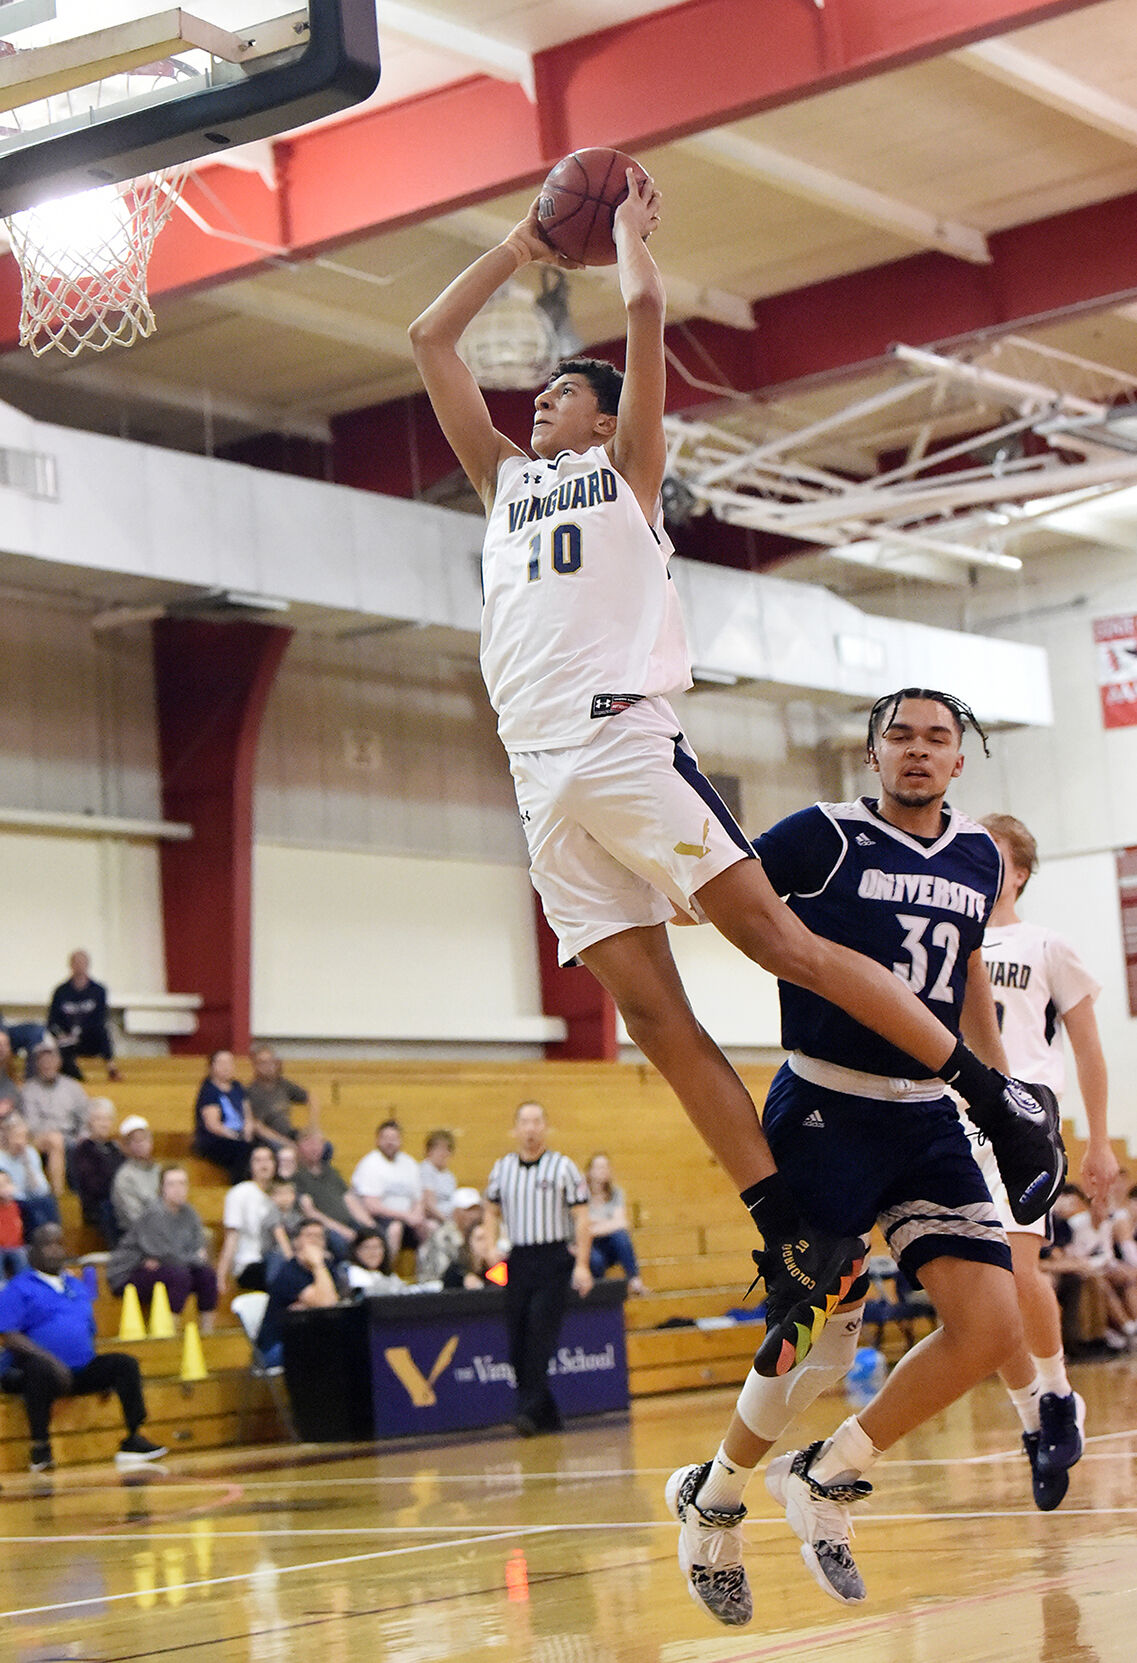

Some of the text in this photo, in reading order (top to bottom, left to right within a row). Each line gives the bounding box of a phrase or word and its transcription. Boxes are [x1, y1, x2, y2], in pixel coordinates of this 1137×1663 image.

[508, 468, 617, 533] VANGUARD
[527, 522, 584, 583] 10
[857, 868, 987, 923] UNIVERSITY
[892, 913, 961, 1004] 32
[781, 1243, 817, 1290] COLORADO
[795, 1239, 810, 1253] 10
